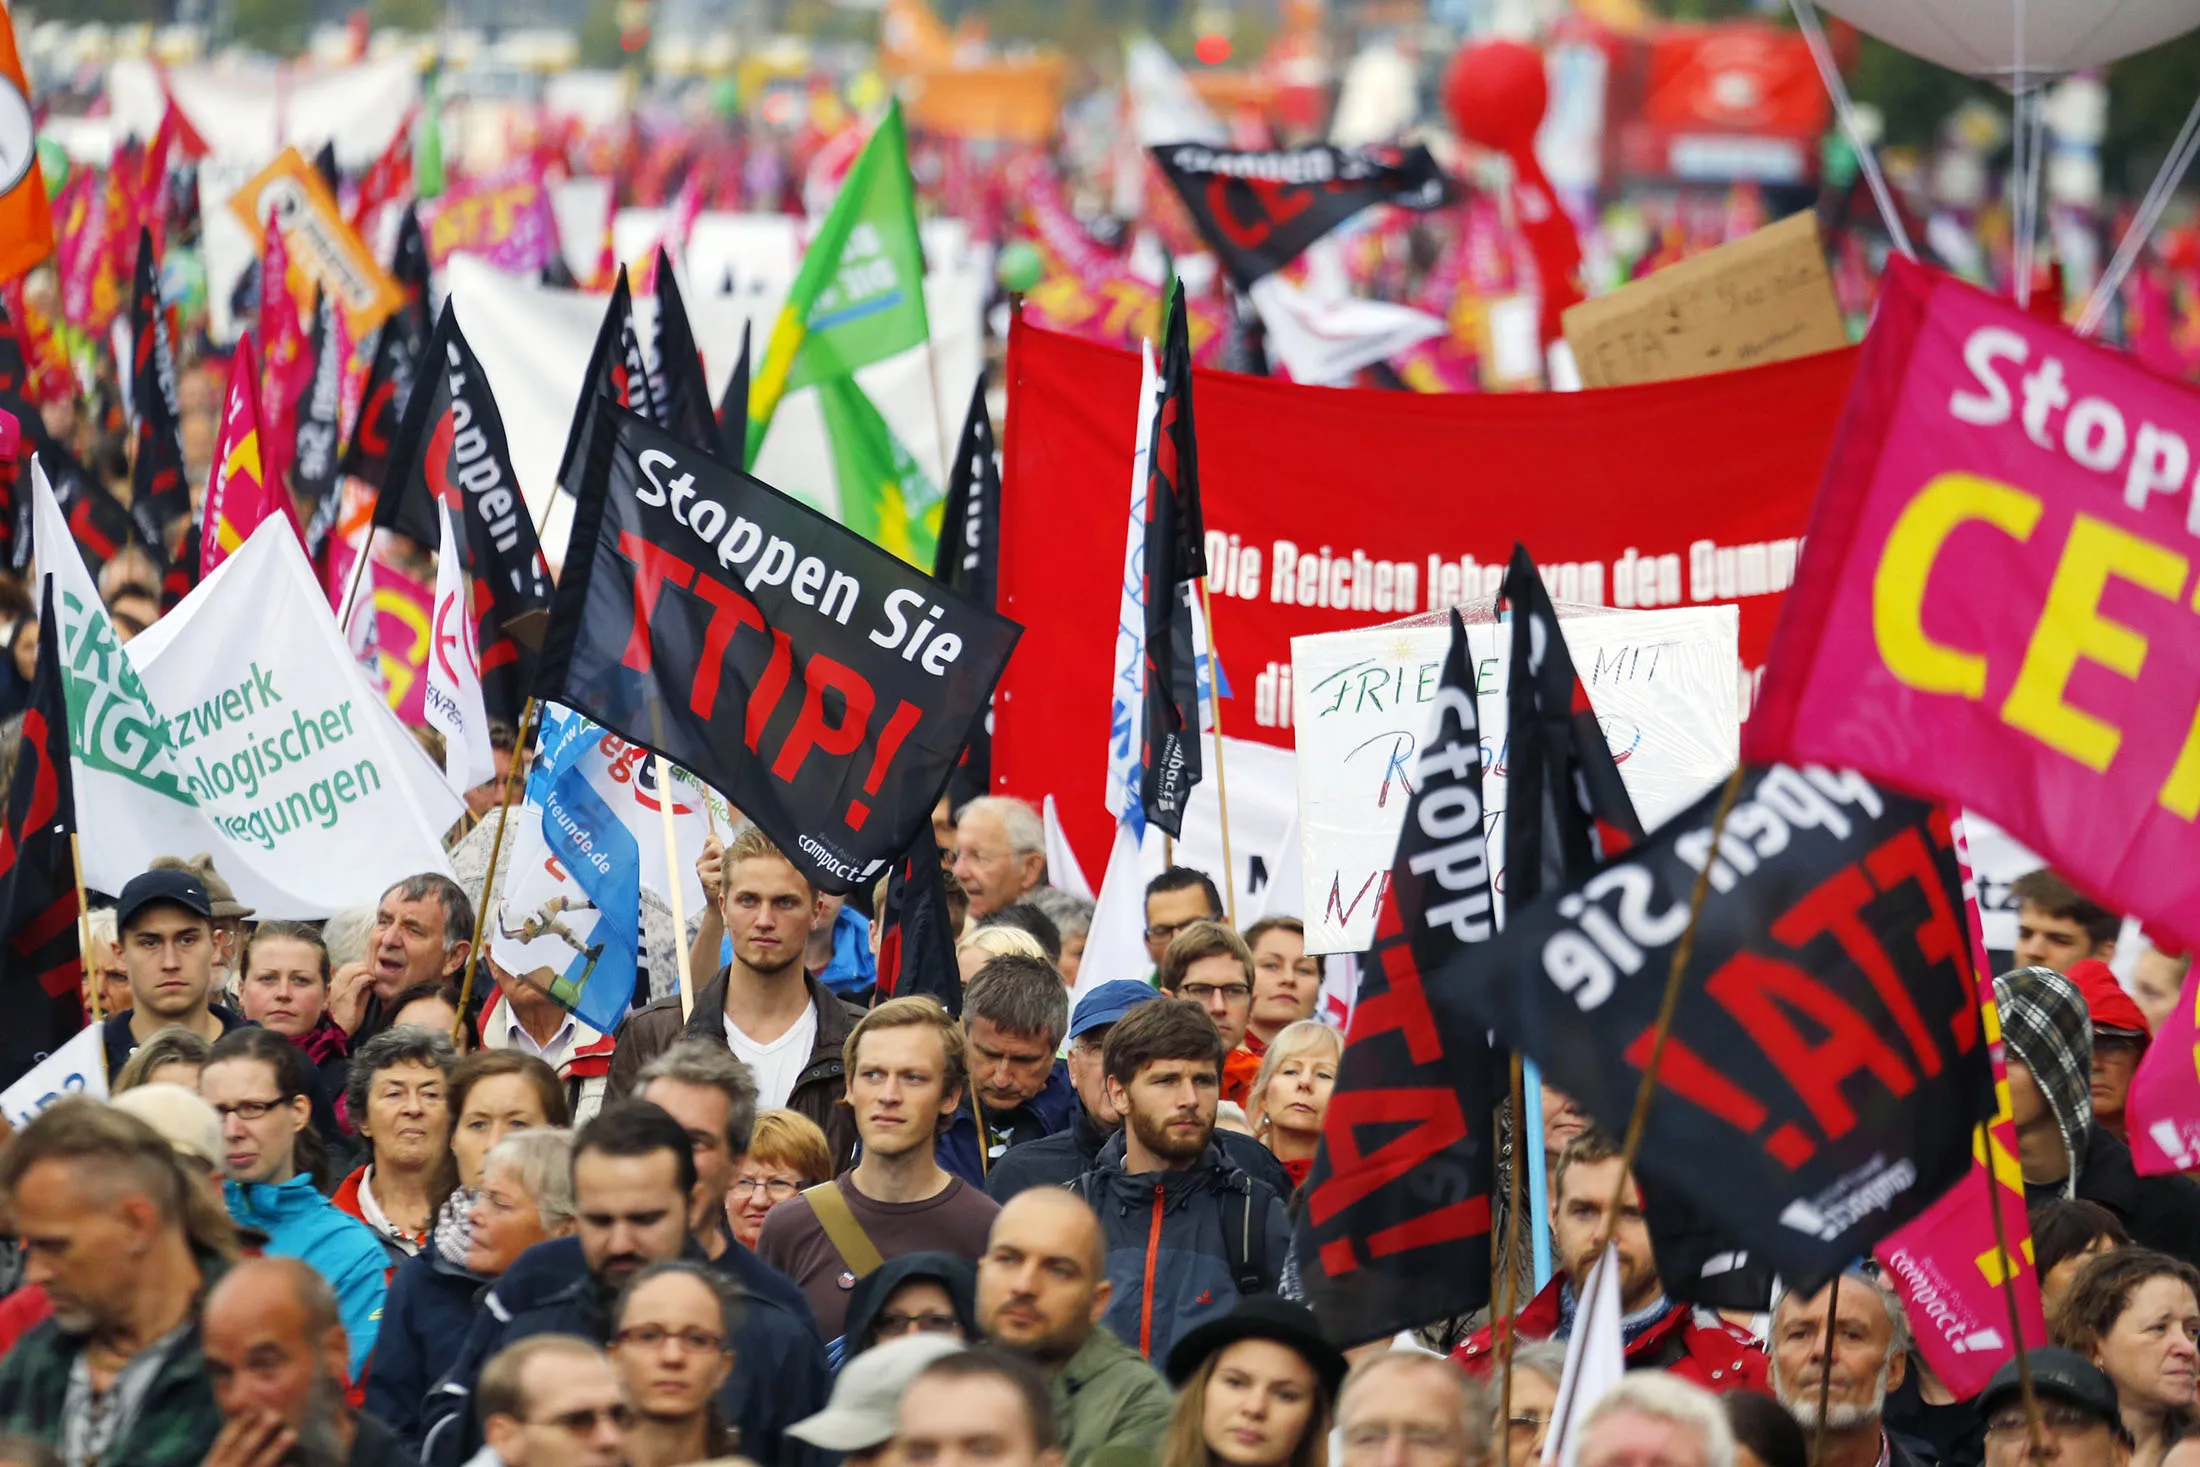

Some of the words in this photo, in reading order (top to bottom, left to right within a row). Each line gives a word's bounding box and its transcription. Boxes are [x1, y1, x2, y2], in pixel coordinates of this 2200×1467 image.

[1949, 326, 2200, 538] Stop
[635, 449, 860, 625] Stoppen
[869, 589, 963, 676] Sie
[1204, 530, 1262, 600] Die
[1270, 539, 1418, 613] Reichen
[1613, 546, 1682, 608] den
[1690, 536, 1806, 602] Dumm
[618, 529, 923, 832] TTIP!
[1254, 660, 1294, 729] di
[1310, 658, 1500, 718] FRIEE
[1593, 640, 1684, 686] MIT
[1872, 470, 2200, 822] CE
[165, 662, 283, 757] tzwerk
[214, 759, 381, 850] egungen
[1404, 685, 1493, 944] Stopp
[797, 834, 887, 884] campact!
[1889, 1247, 2005, 1355] campact!
